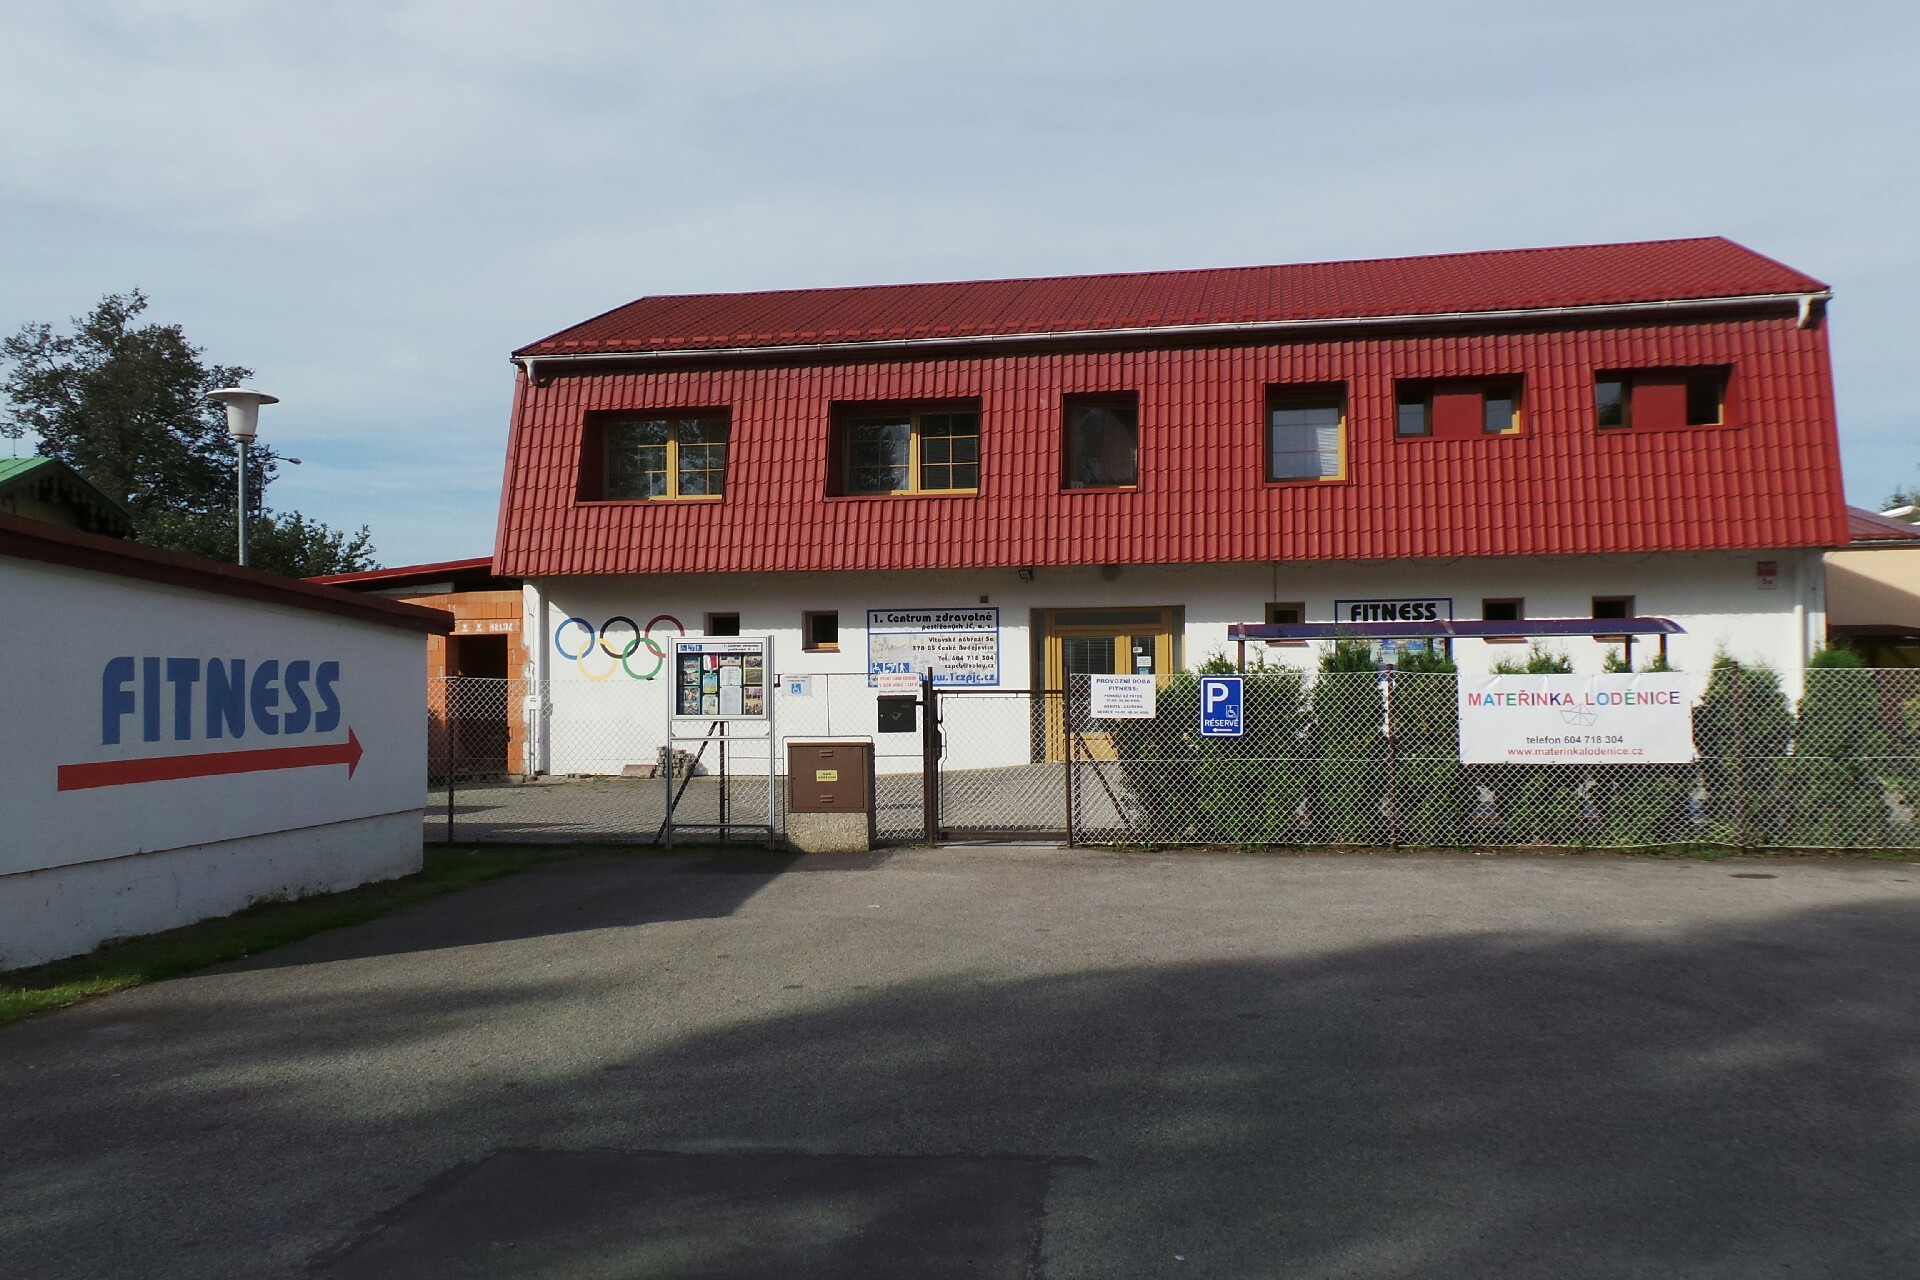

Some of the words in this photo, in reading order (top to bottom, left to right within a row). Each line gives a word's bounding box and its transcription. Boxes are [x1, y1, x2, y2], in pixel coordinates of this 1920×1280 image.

[873, 613, 884, 624] 1.
[887, 613, 932, 623] Centrum
[935, 611, 993, 622] zdravotně
[1350, 602, 1438, 622] FITNESS
[958, 644, 994, 652] Budějovice
[102, 656, 341, 746] FITNESS
[1207, 682, 1229, 713] P
[1468, 690, 1575, 706] MATEŘINKA
[1585, 689, 1681, 706] LODĚNICE
[1204, 717, 1239, 727] RÉSERVÉ
[1526, 735, 1561, 744] telefon
[1564, 736, 1581, 744] 604
[1585, 736, 1602, 744] 718
[1605, 736, 1624, 744] 304
[1507, 747, 1644, 756] www.materinkalodenice.cz
